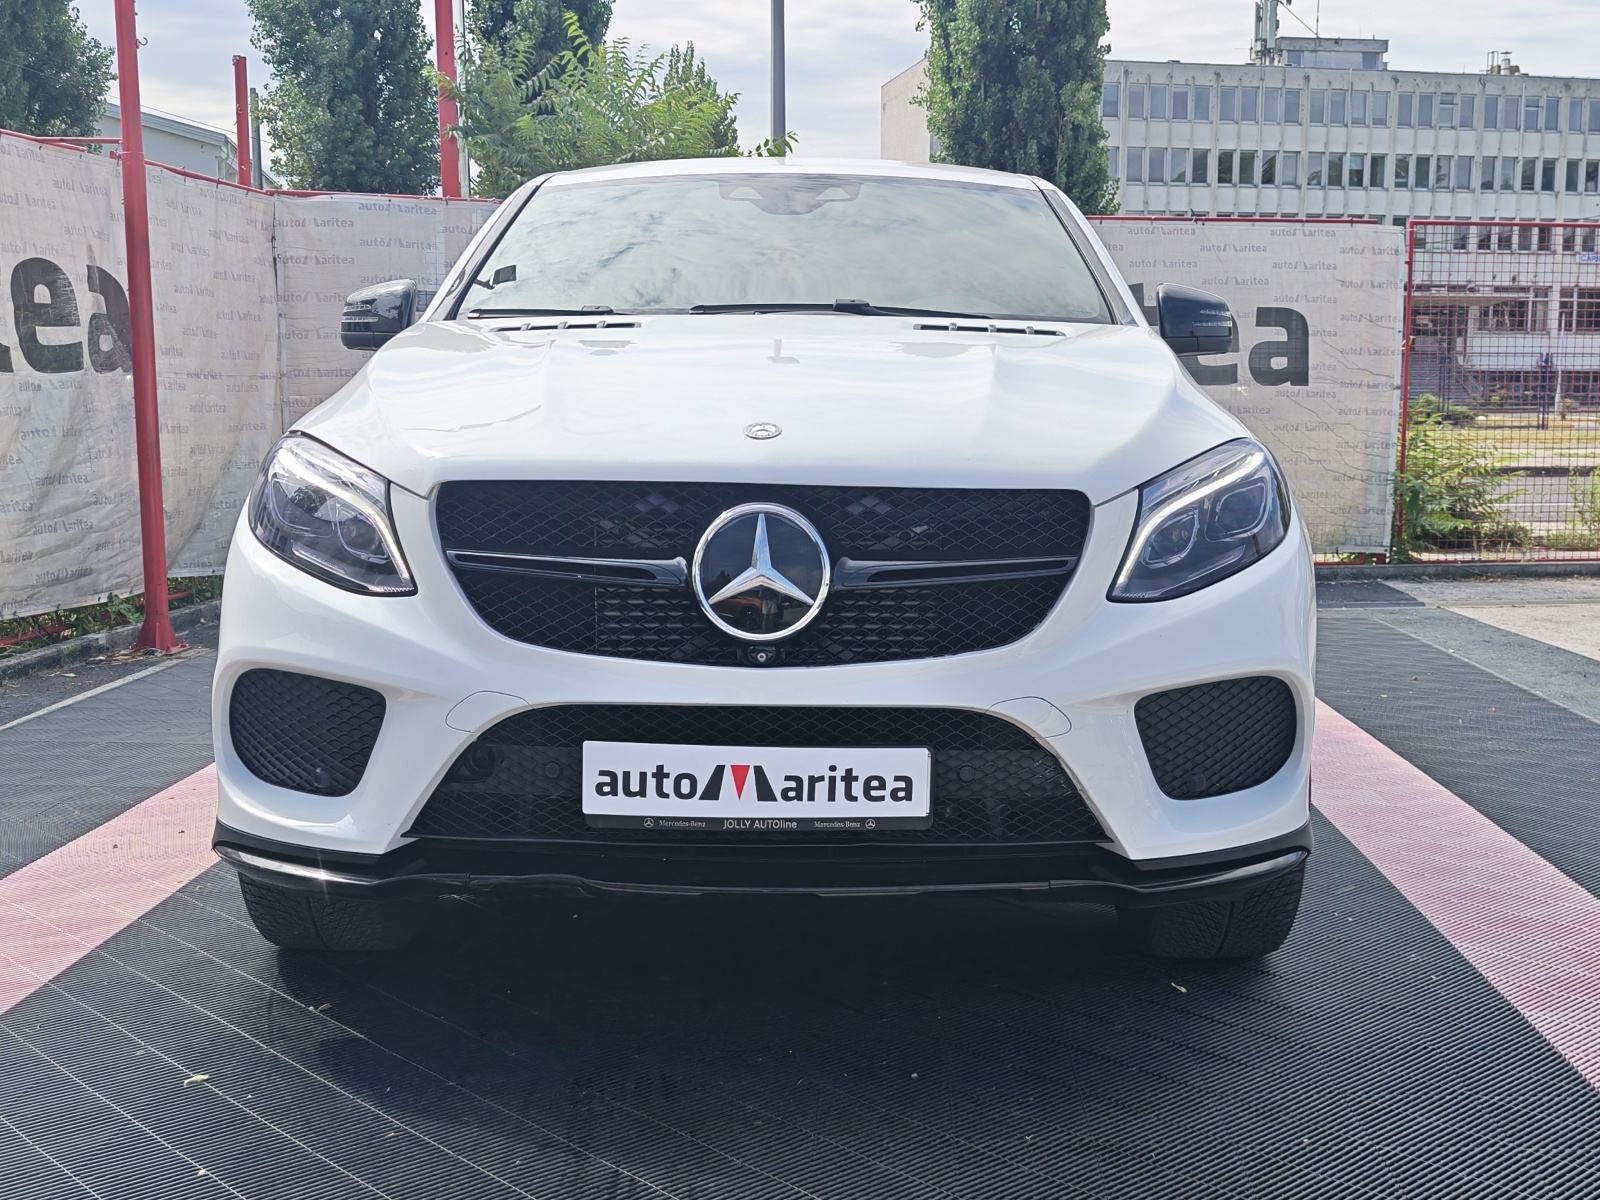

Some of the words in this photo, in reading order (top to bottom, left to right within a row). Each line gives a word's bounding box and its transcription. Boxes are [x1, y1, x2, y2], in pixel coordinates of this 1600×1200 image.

[659, 820, 706, 828] Mercedes-Benz
[723, 819, 751, 829] JOLLY
[753, 820, 798, 829] AUTOline
[814, 820, 861, 828] Mercedes-Benz
